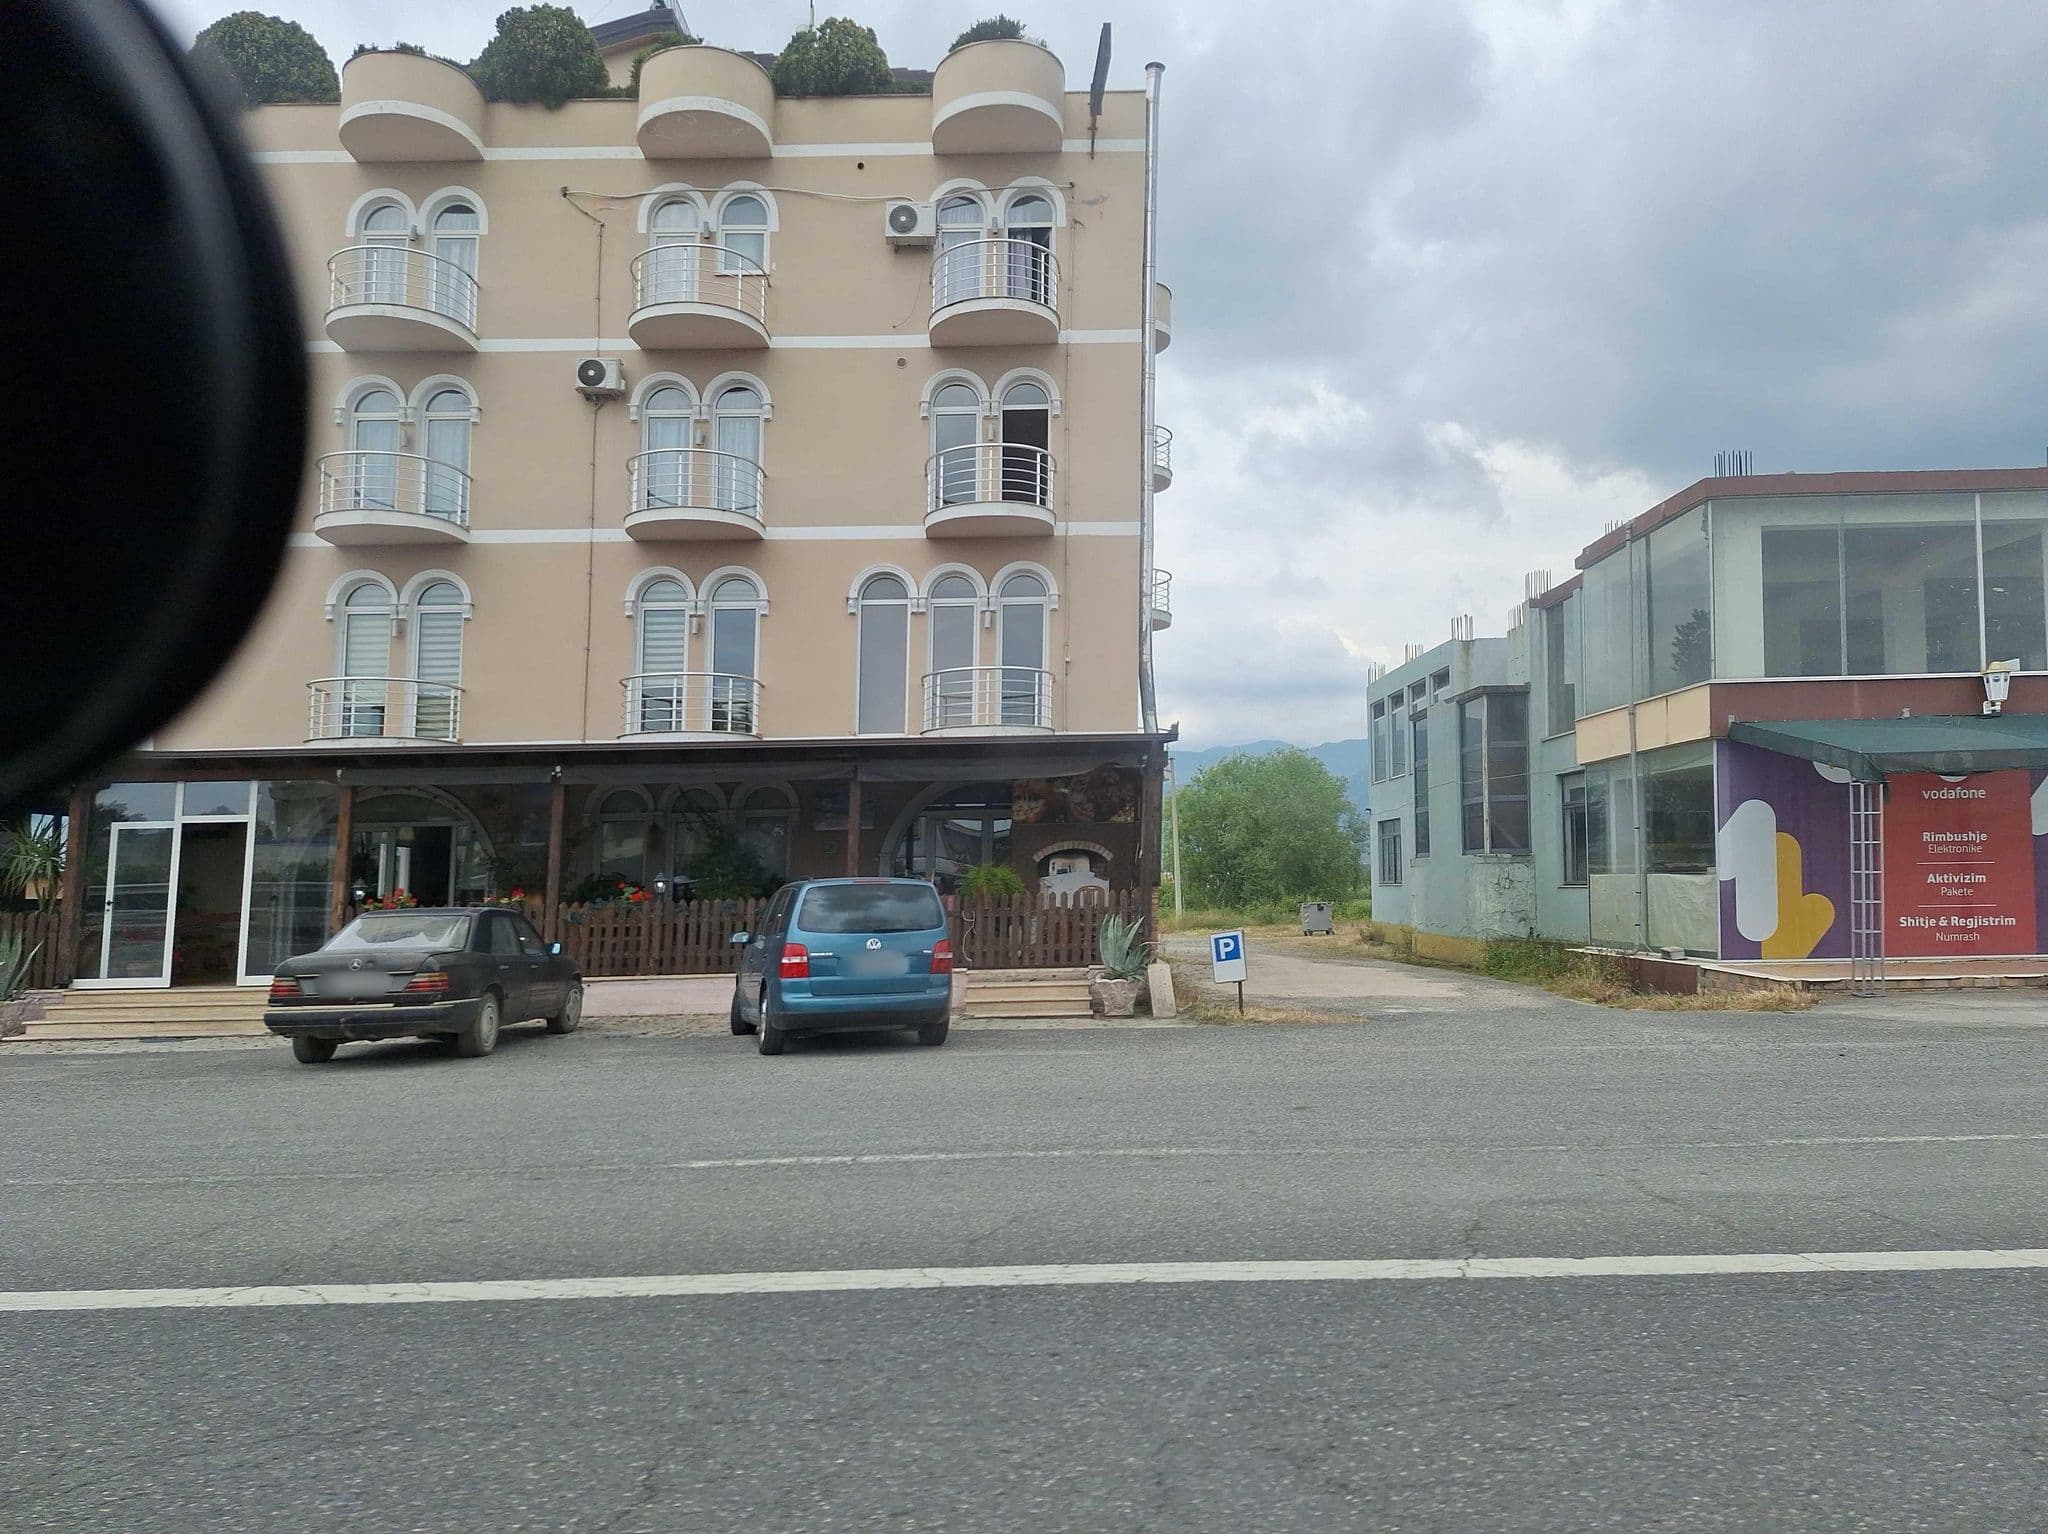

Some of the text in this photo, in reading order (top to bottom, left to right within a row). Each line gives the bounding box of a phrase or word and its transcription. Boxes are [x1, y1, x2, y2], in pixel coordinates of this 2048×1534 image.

[1922, 787, 1987, 799] vodafone
[1923, 831, 1987, 843] Rimbushje
[1928, 843, 1983, 854] Elektronike
[1927, 872, 1987, 884] Aktivizim
[1941, 886, 1974, 896] Pakete
[1900, 916, 2016, 928] Shitje & Regjistrim
[1936, 932, 1980, 942] Numrash
[1219, 938, 1235, 959] P
